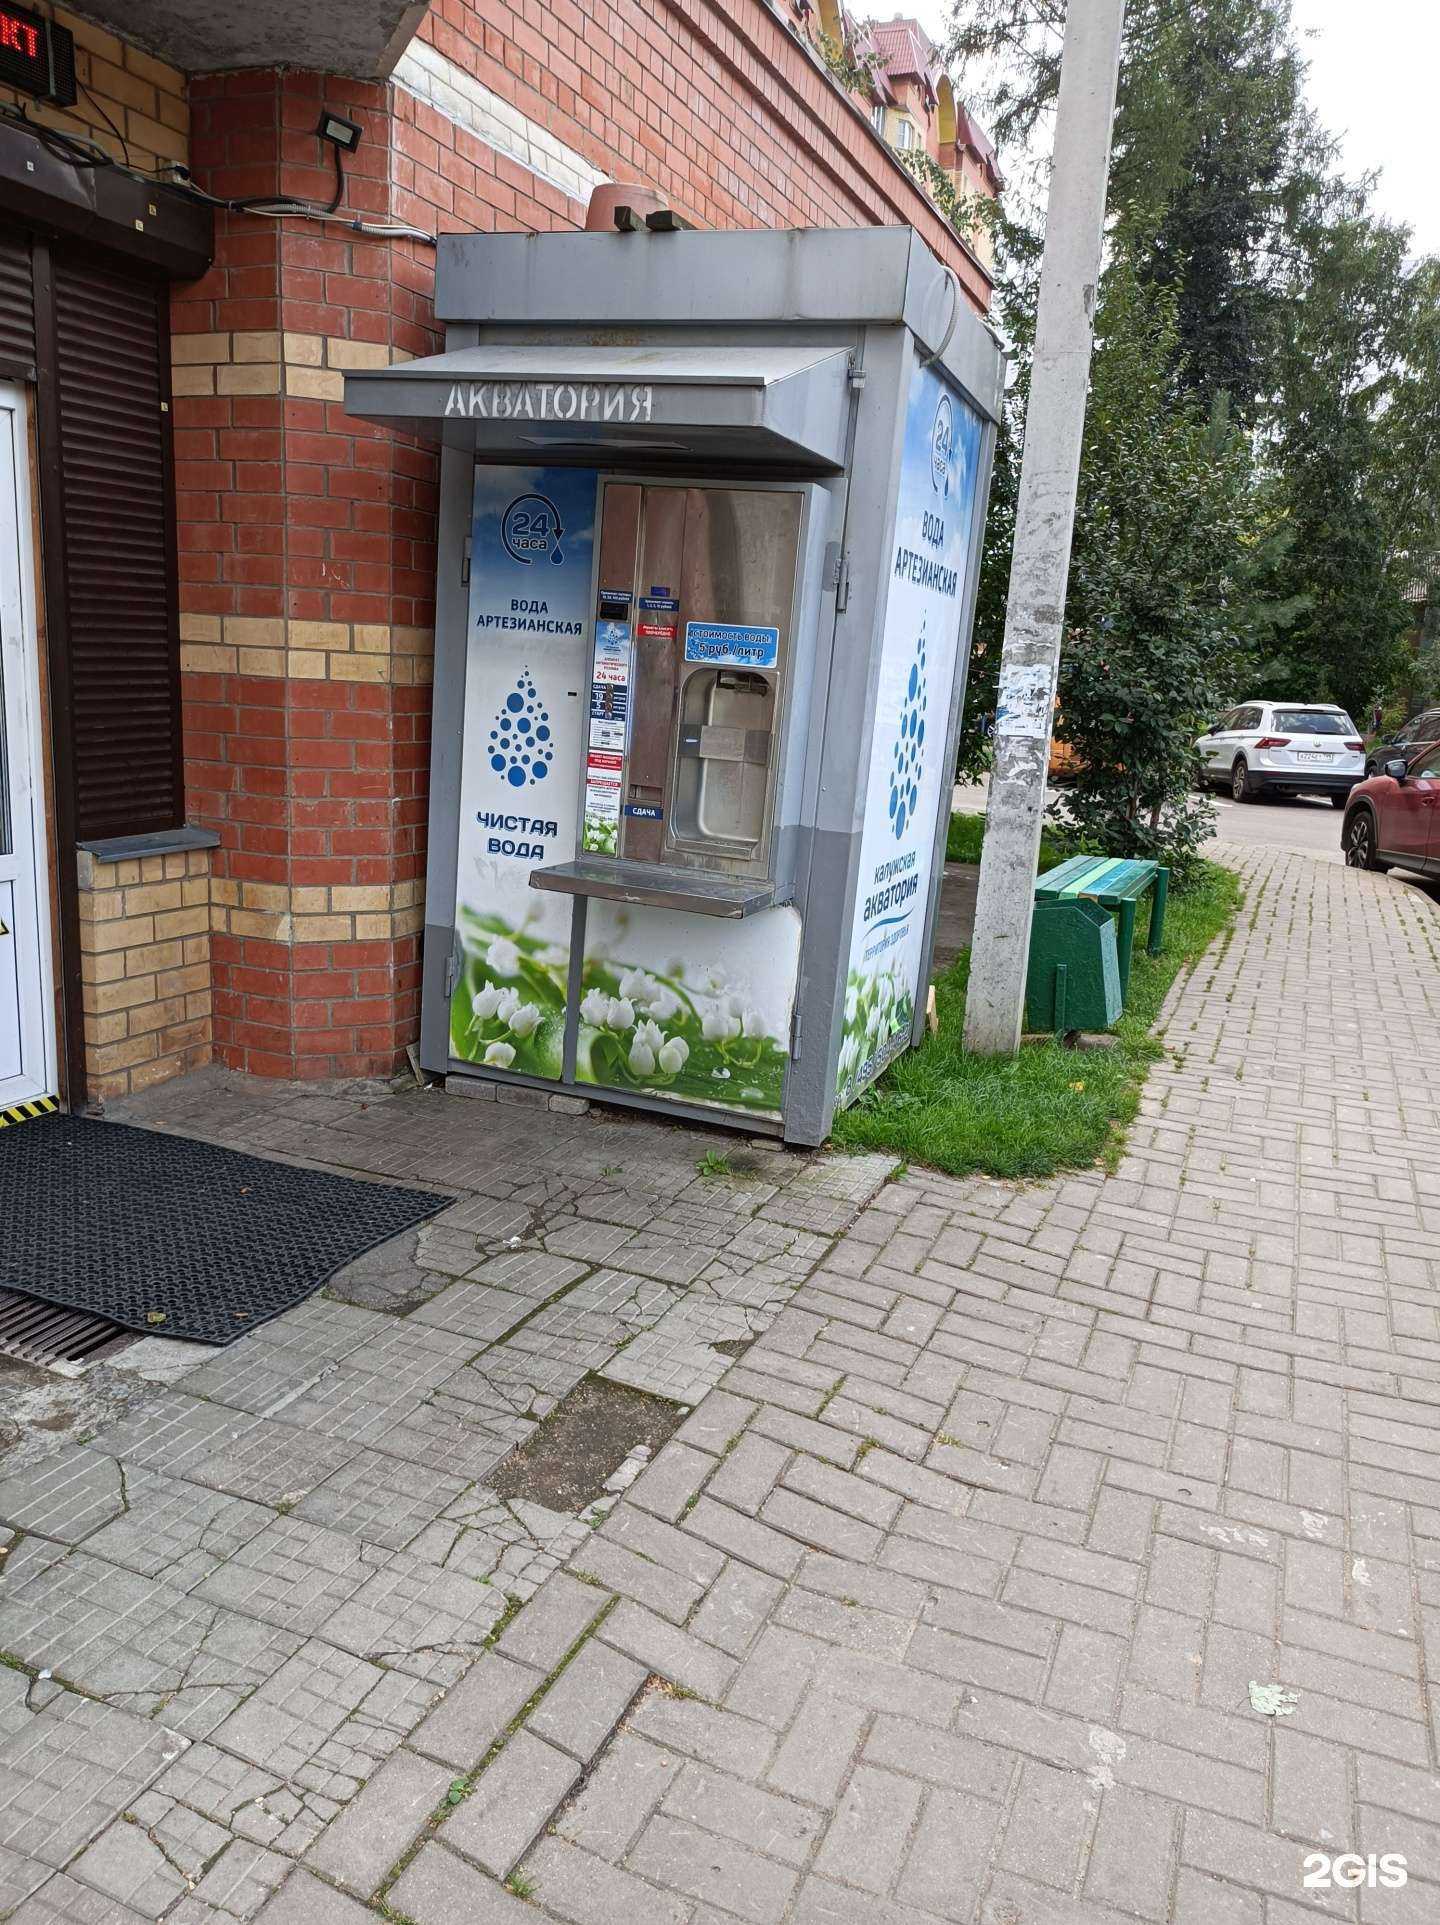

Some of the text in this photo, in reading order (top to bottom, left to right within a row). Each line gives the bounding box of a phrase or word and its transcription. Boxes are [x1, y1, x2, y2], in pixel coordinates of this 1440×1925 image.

[444, 381, 655, 422] АКВАТОРИЯ
[936, 419, 949, 456] 24
[511, 512, 549, 537] 24
[922, 510, 944, 550] ВОДА
[512, 537, 548, 550] часа
[894, 546, 958, 599] АРТЕЗИАНСКАЯ
[511, 598, 549, 614] ВОДА
[476, 614, 583, 635] АРТЕЗИАНСКАЯ
[699, 643, 706, 653] 5
[744, 633, 770, 643] воды
[596, 671, 626, 682] 24 часа
[476, 811, 558, 837] ЧИСТАЯ
[632, 807, 656, 817] СДАЧА
[487, 838, 545, 861] ВОДА
[873, 851, 916, 885] калужская
[863, 873, 919, 922] акватория
